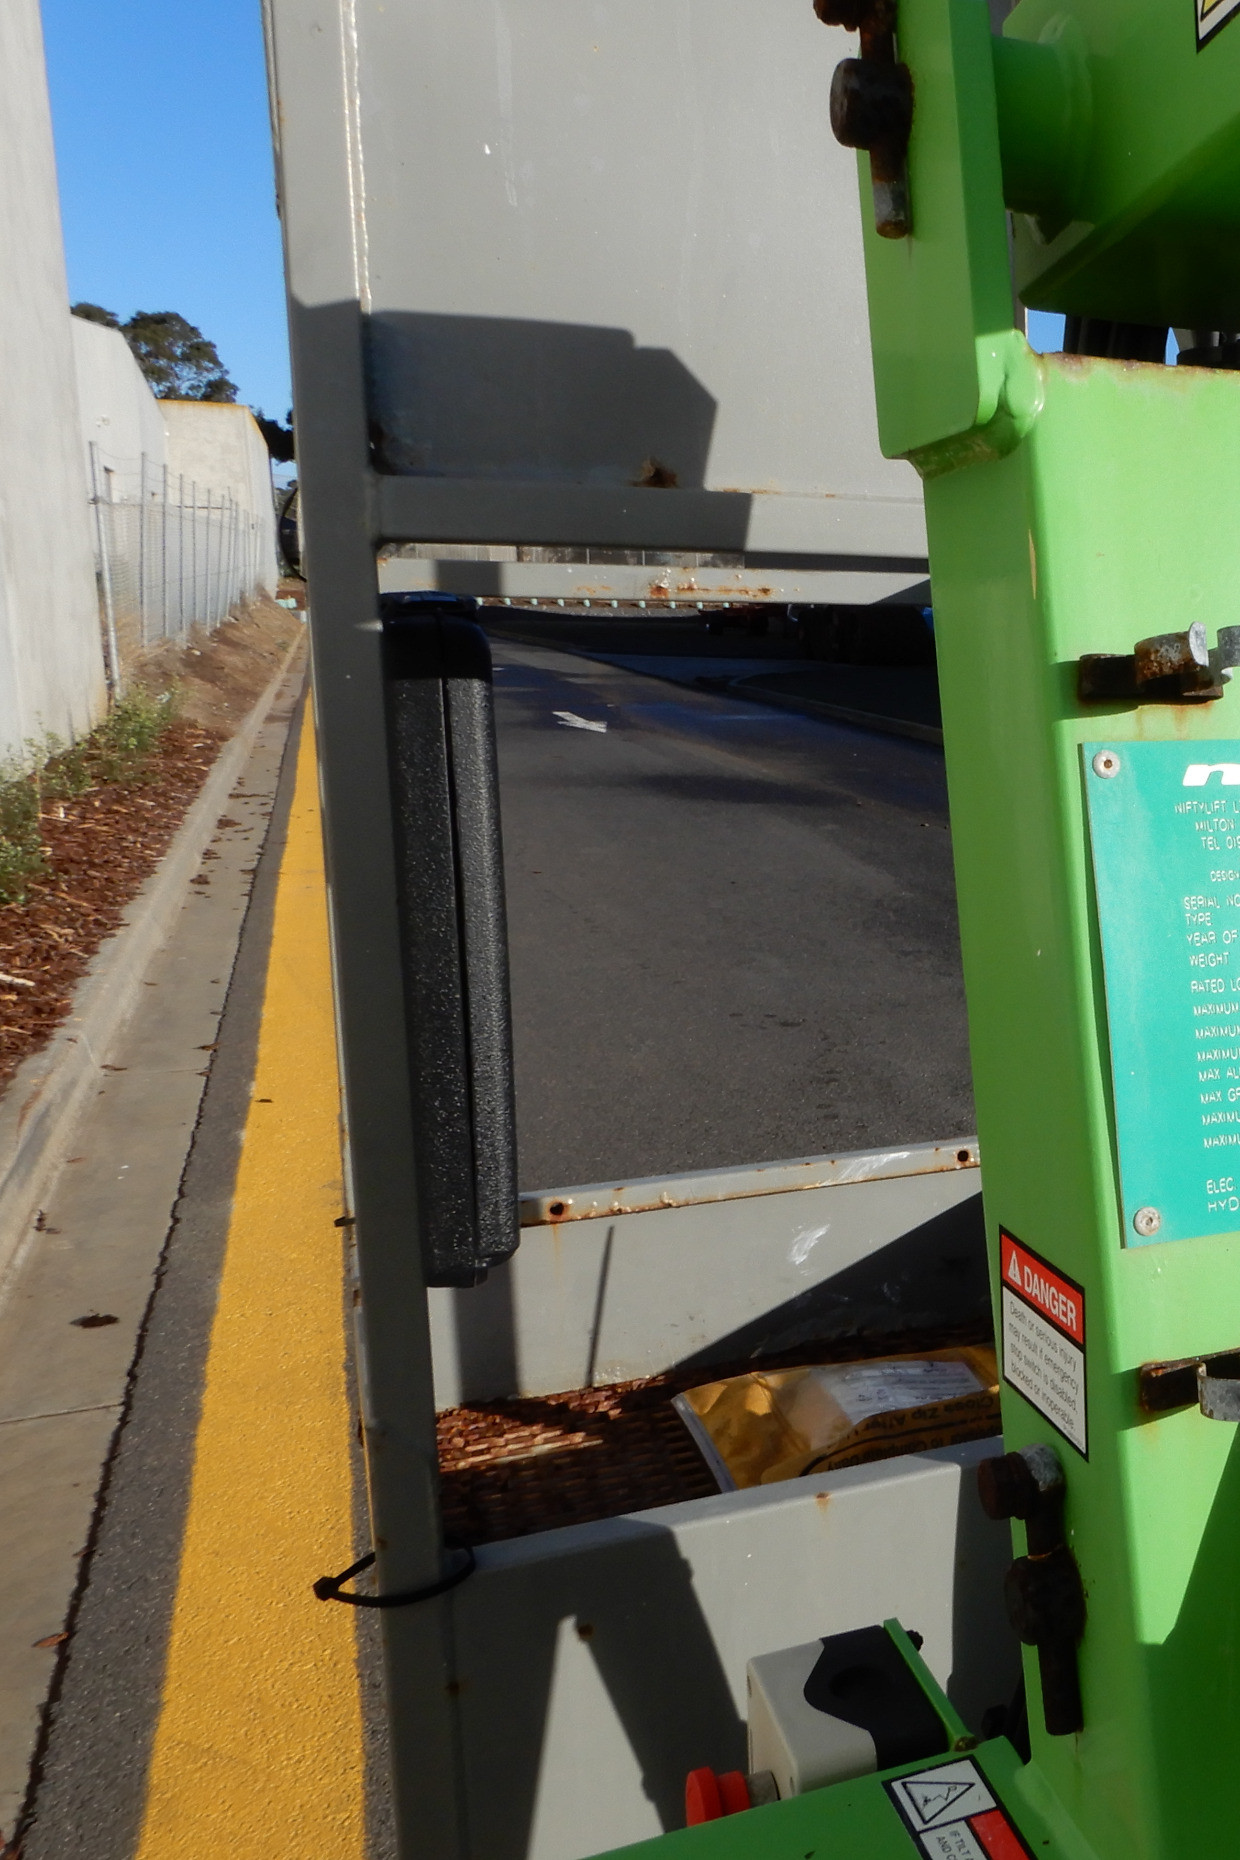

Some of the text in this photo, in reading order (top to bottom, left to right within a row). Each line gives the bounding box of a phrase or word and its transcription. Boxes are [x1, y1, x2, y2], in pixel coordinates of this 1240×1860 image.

[1174, 799, 1227, 814] NIFTYLIFT
[1195, 818, 1235, 832] MILTON
[1201, 836, 1220, 850] TEL
[1183, 895, 1221, 910] SERIAL
[1185, 911, 1213, 926] TYPE
[1186, 930, 1217, 946] YEAR
[1222, 929, 1238, 944] OF
[1189, 951, 1229, 967] WEIGHT
[1190, 978, 1225, 993] RATED
[1193, 1002, 1239, 1017] MAXIMUM
[1199, 1068, 1221, 1082] MAX
[1200, 1090, 1222, 1104] MAX
[1023, 1265, 1077, 1332] DANGER
